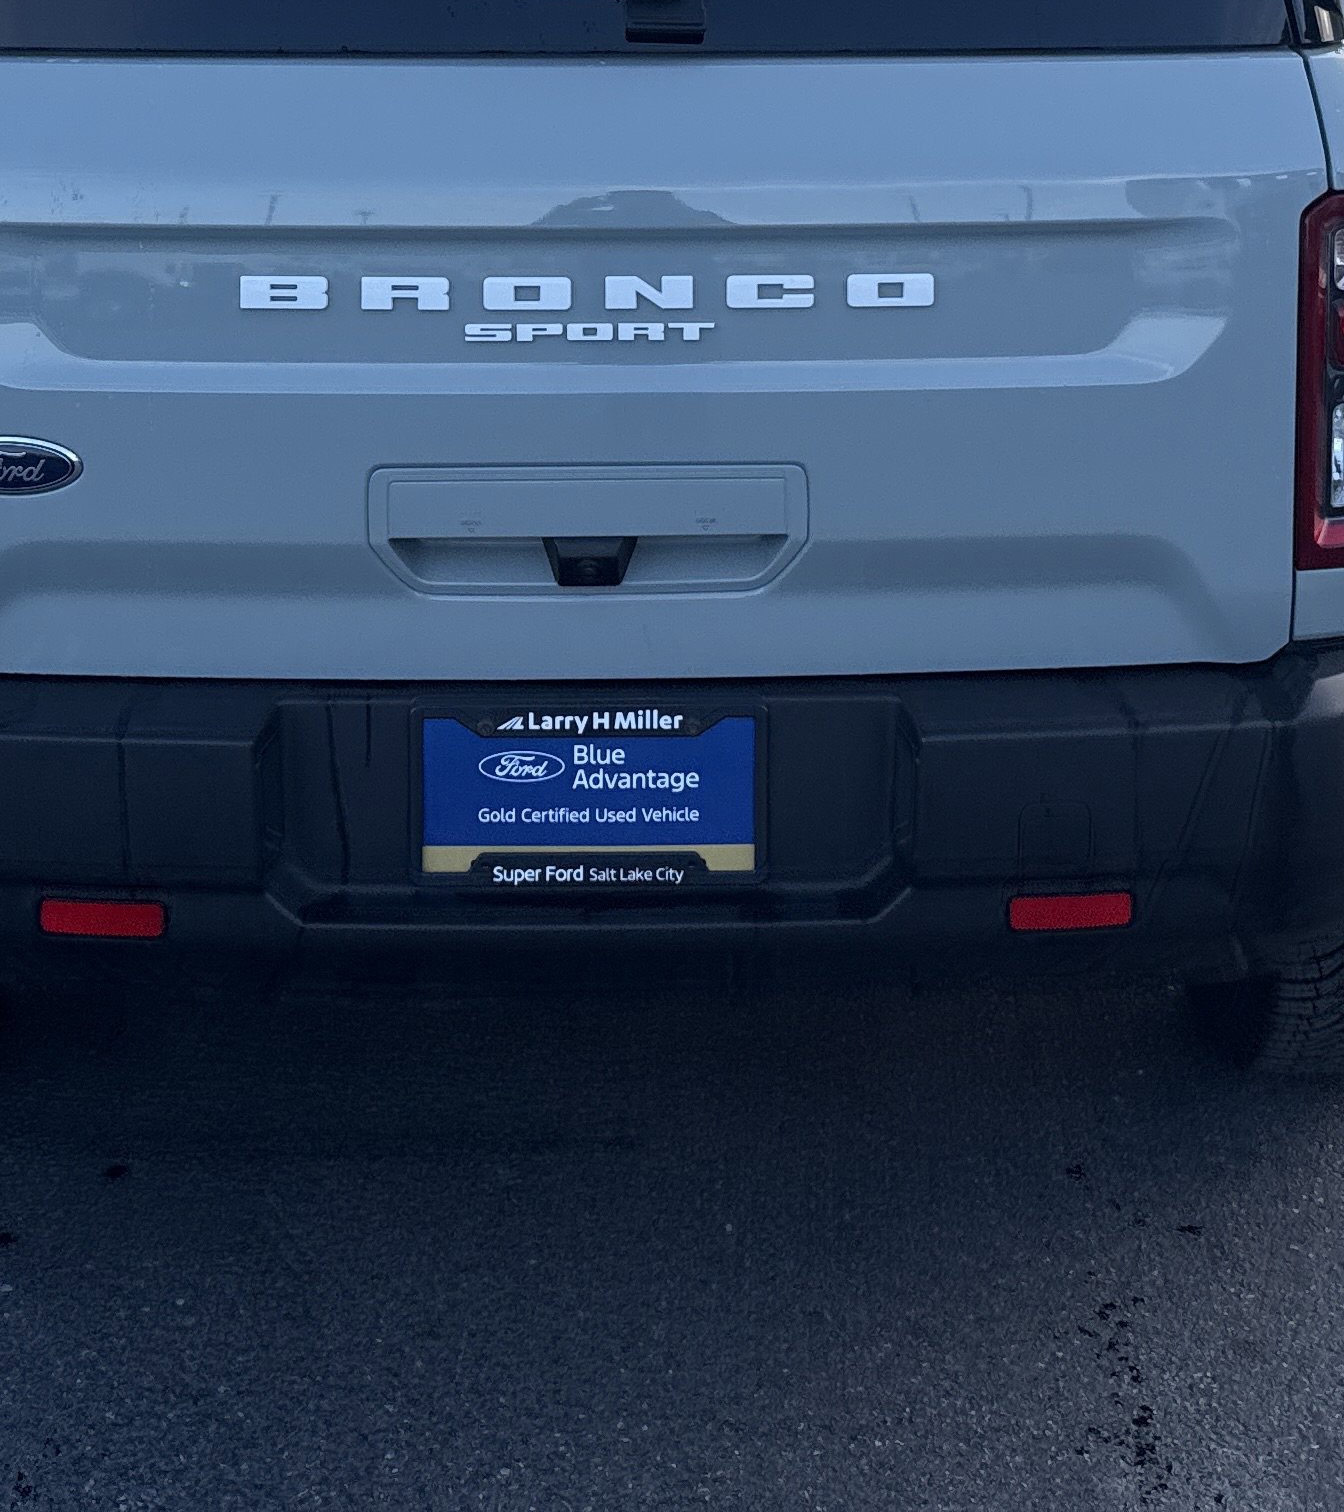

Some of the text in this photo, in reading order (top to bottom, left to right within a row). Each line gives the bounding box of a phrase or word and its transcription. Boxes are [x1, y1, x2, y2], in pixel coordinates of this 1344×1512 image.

[239, 273, 935, 310] BRONCO
[464, 322, 715, 342] SPORT
[528, 709, 684, 735] Larry H Miller
[573, 743, 626, 765] Blue
[494, 754, 549, 778] Ford
[572, 768, 700, 793] Advantage
[478, 806, 700, 823] Gold Certified Used Vehicle
[492, 864, 685, 886] Super Ford Salt Lake City
